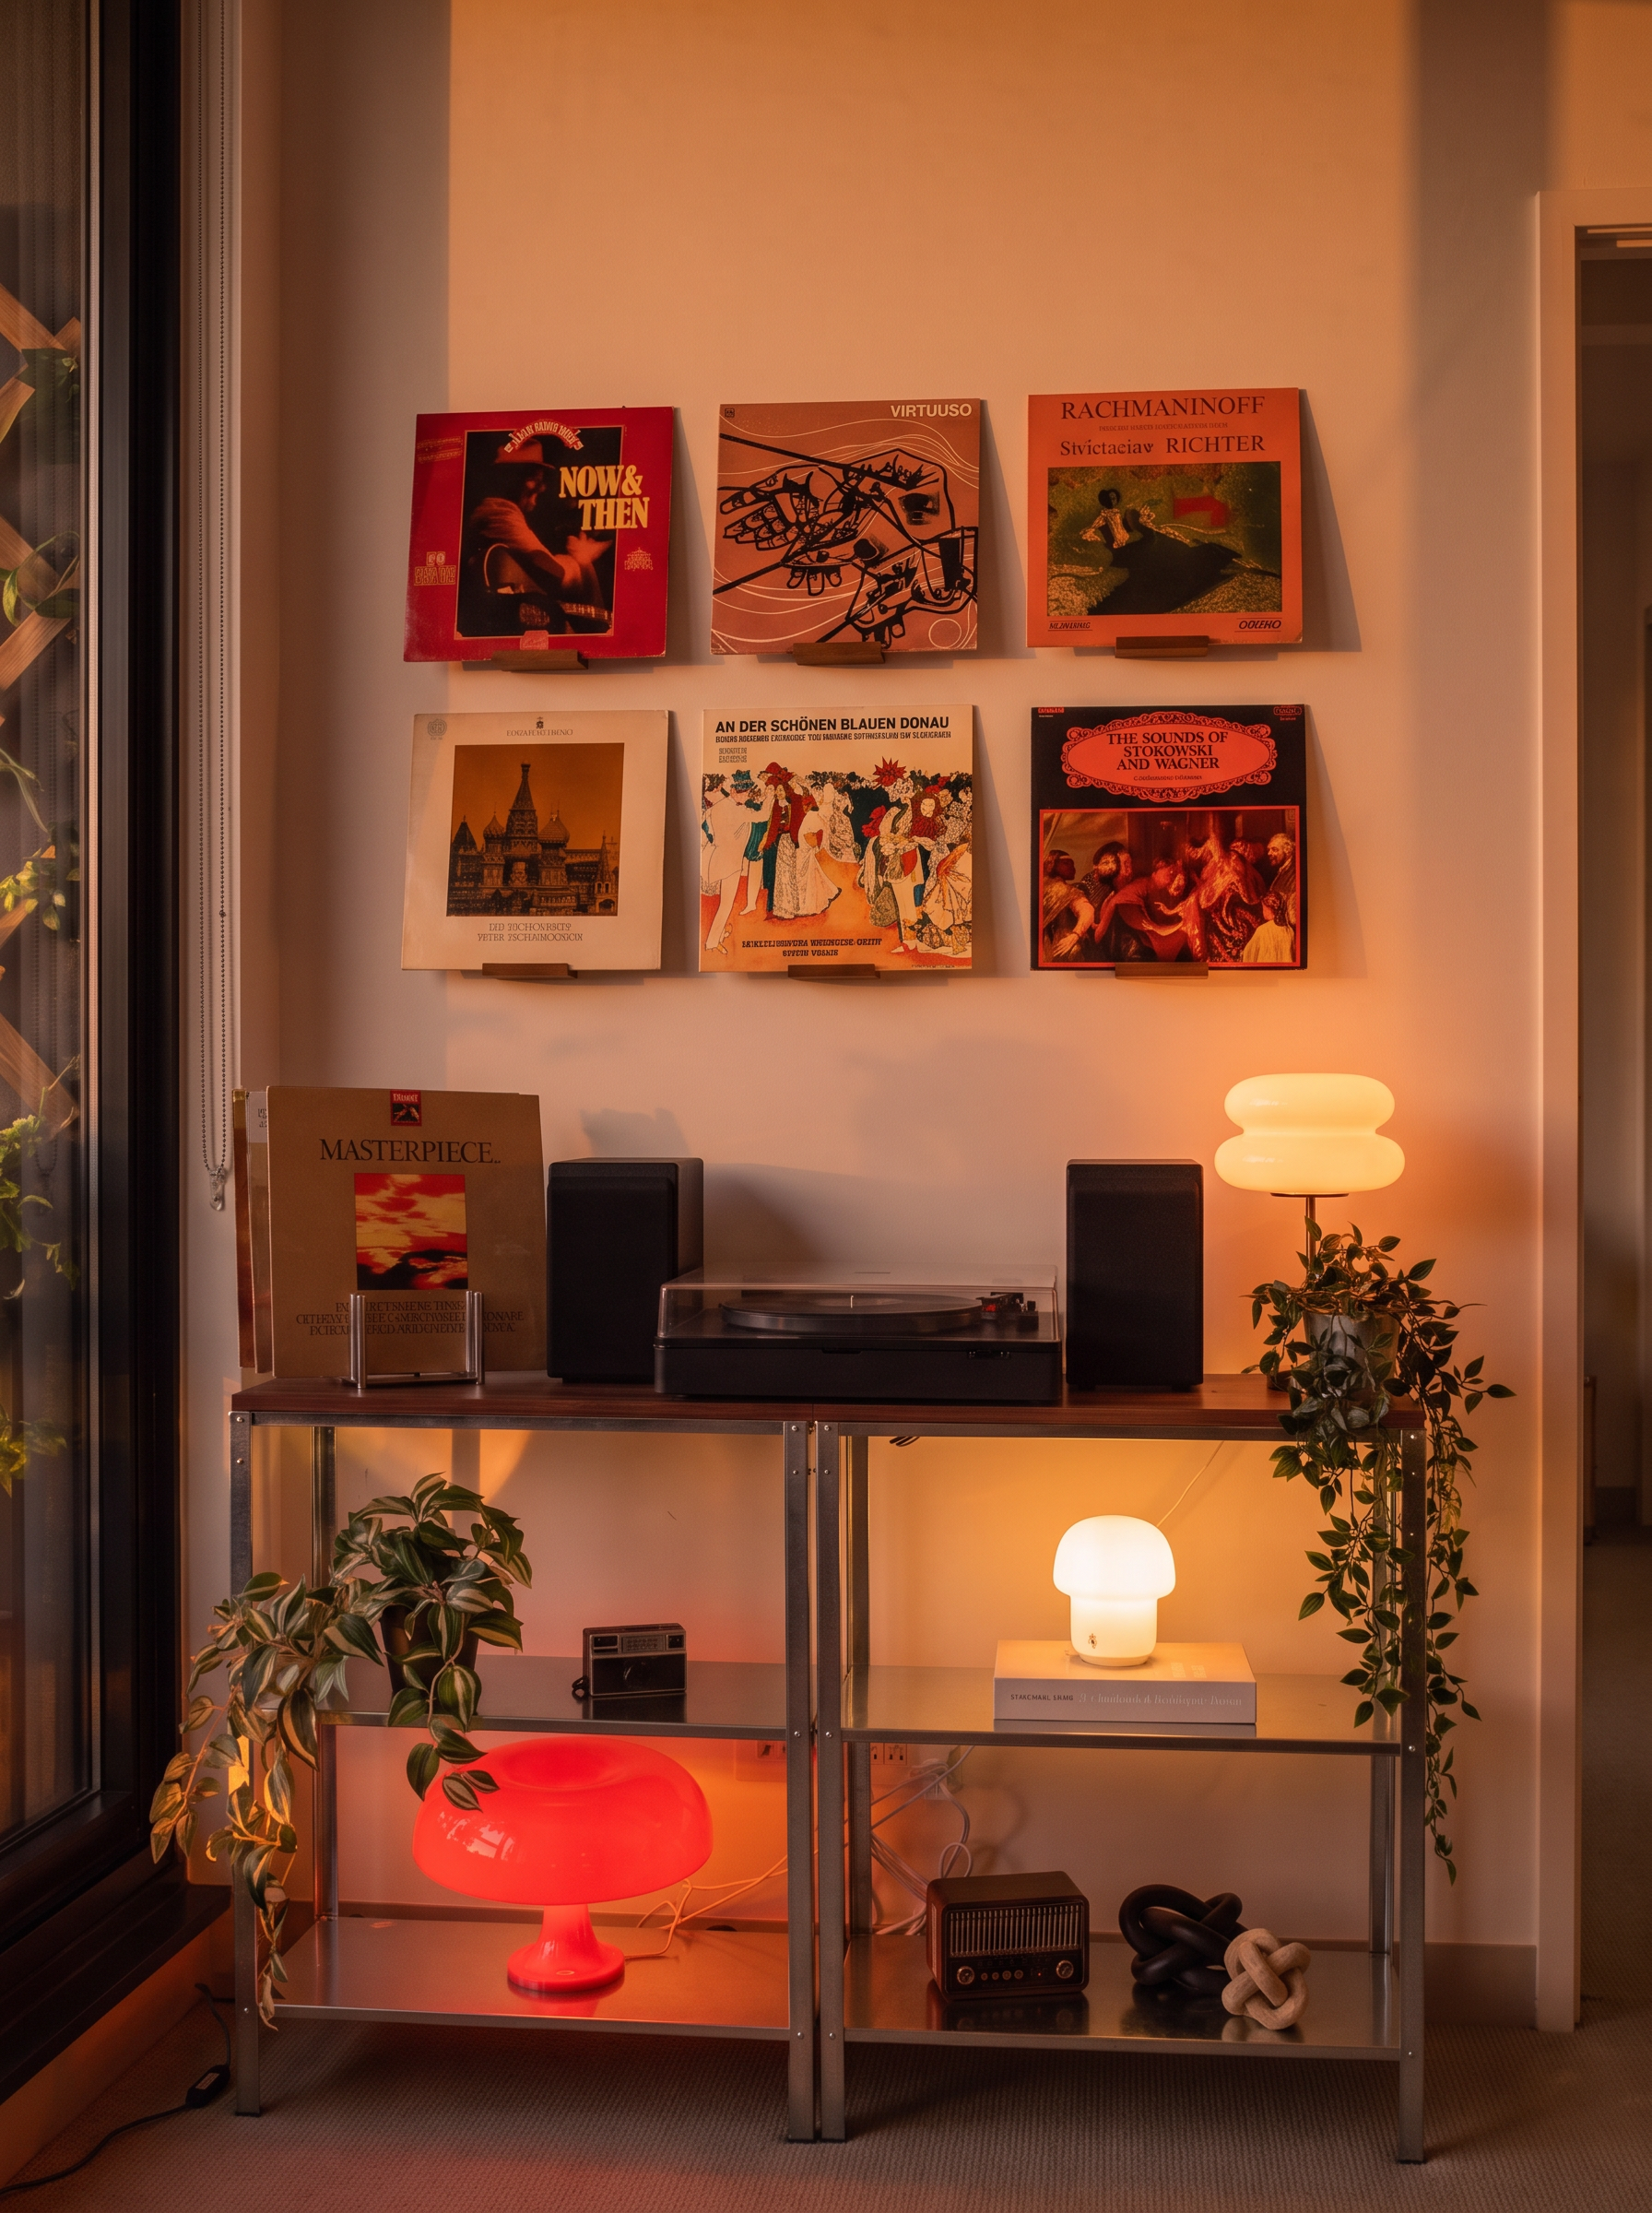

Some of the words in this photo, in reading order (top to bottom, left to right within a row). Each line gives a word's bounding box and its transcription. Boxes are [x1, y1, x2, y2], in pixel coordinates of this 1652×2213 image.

[891, 403, 973, 418] VIRTUUSO
[1061, 396, 1265, 420] RACHMANINOFF
[1166, 435, 1266, 454] RICHTER
[578, 497, 650, 530] THEN
[715, 721, 735, 733] AN
[739, 720, 767, 732] DER
[771, 716, 836, 731] SCHÖNEN
[841, 717, 896, 730] BLAUEN
[900, 716, 950, 728] DONAU
[1106, 733, 1138, 745] THE
[1142, 731, 1205, 744] SOUNDS
[1208, 731, 1228, 743] OF
[1124, 745, 1213, 757] STOKOWSKI
[1116, 758, 1150, 770] AND
[1154, 757, 1220, 770] WAGNER
